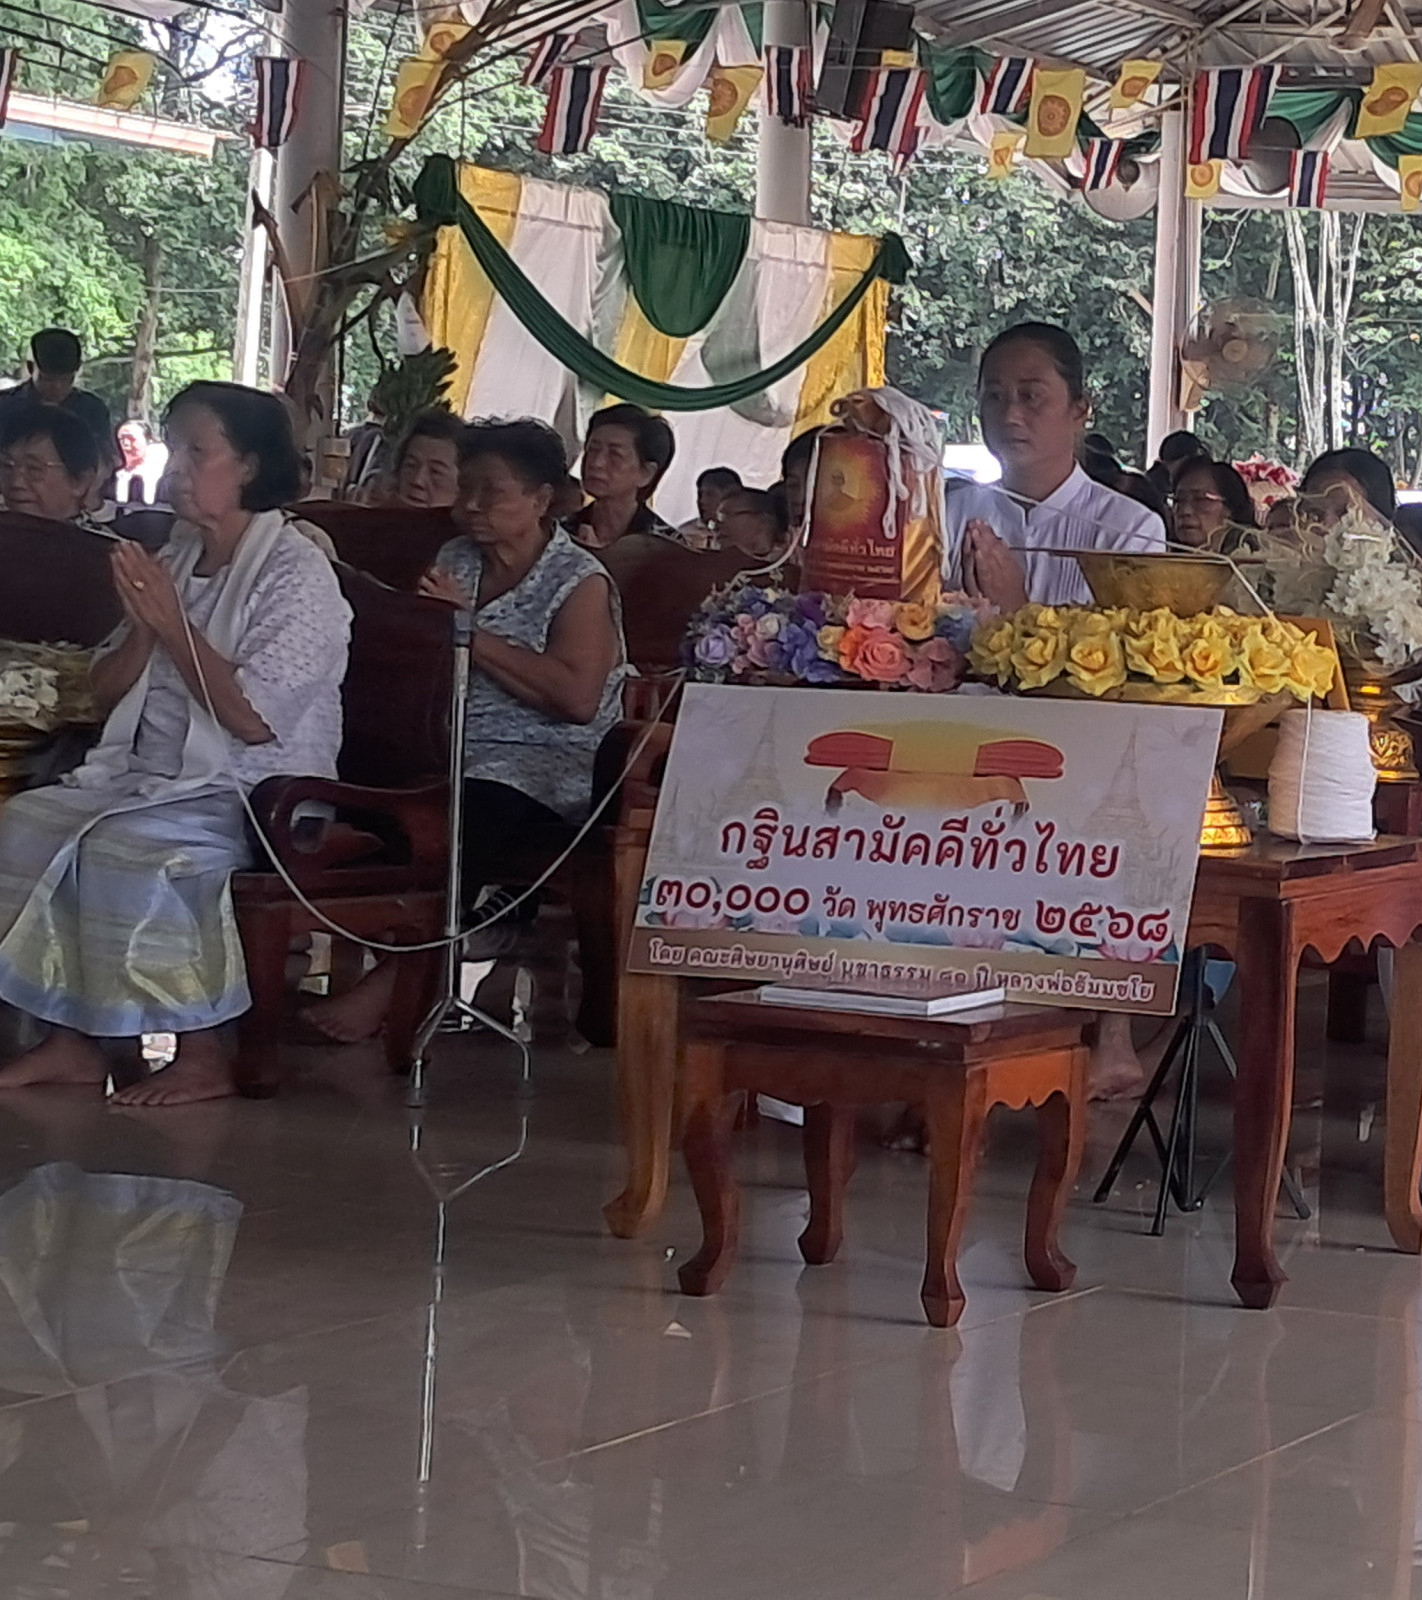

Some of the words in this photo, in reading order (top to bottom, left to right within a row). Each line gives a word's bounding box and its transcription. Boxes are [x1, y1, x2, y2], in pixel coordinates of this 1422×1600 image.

[720, 806, 1121, 879] กฐินสามัคคีทั่วไทย
[655, 879, 810, 916] ๓๐,๐๐๐
[822, 885, 857, 918] วัด
[866, 892, 1022, 932] พุทธศักราช
[1035, 899, 1171, 942] ๒๕๖๘
[651, 939, 685, 963] โดย
[688, 946, 836, 978] คณะศิษยานุศิษย์
